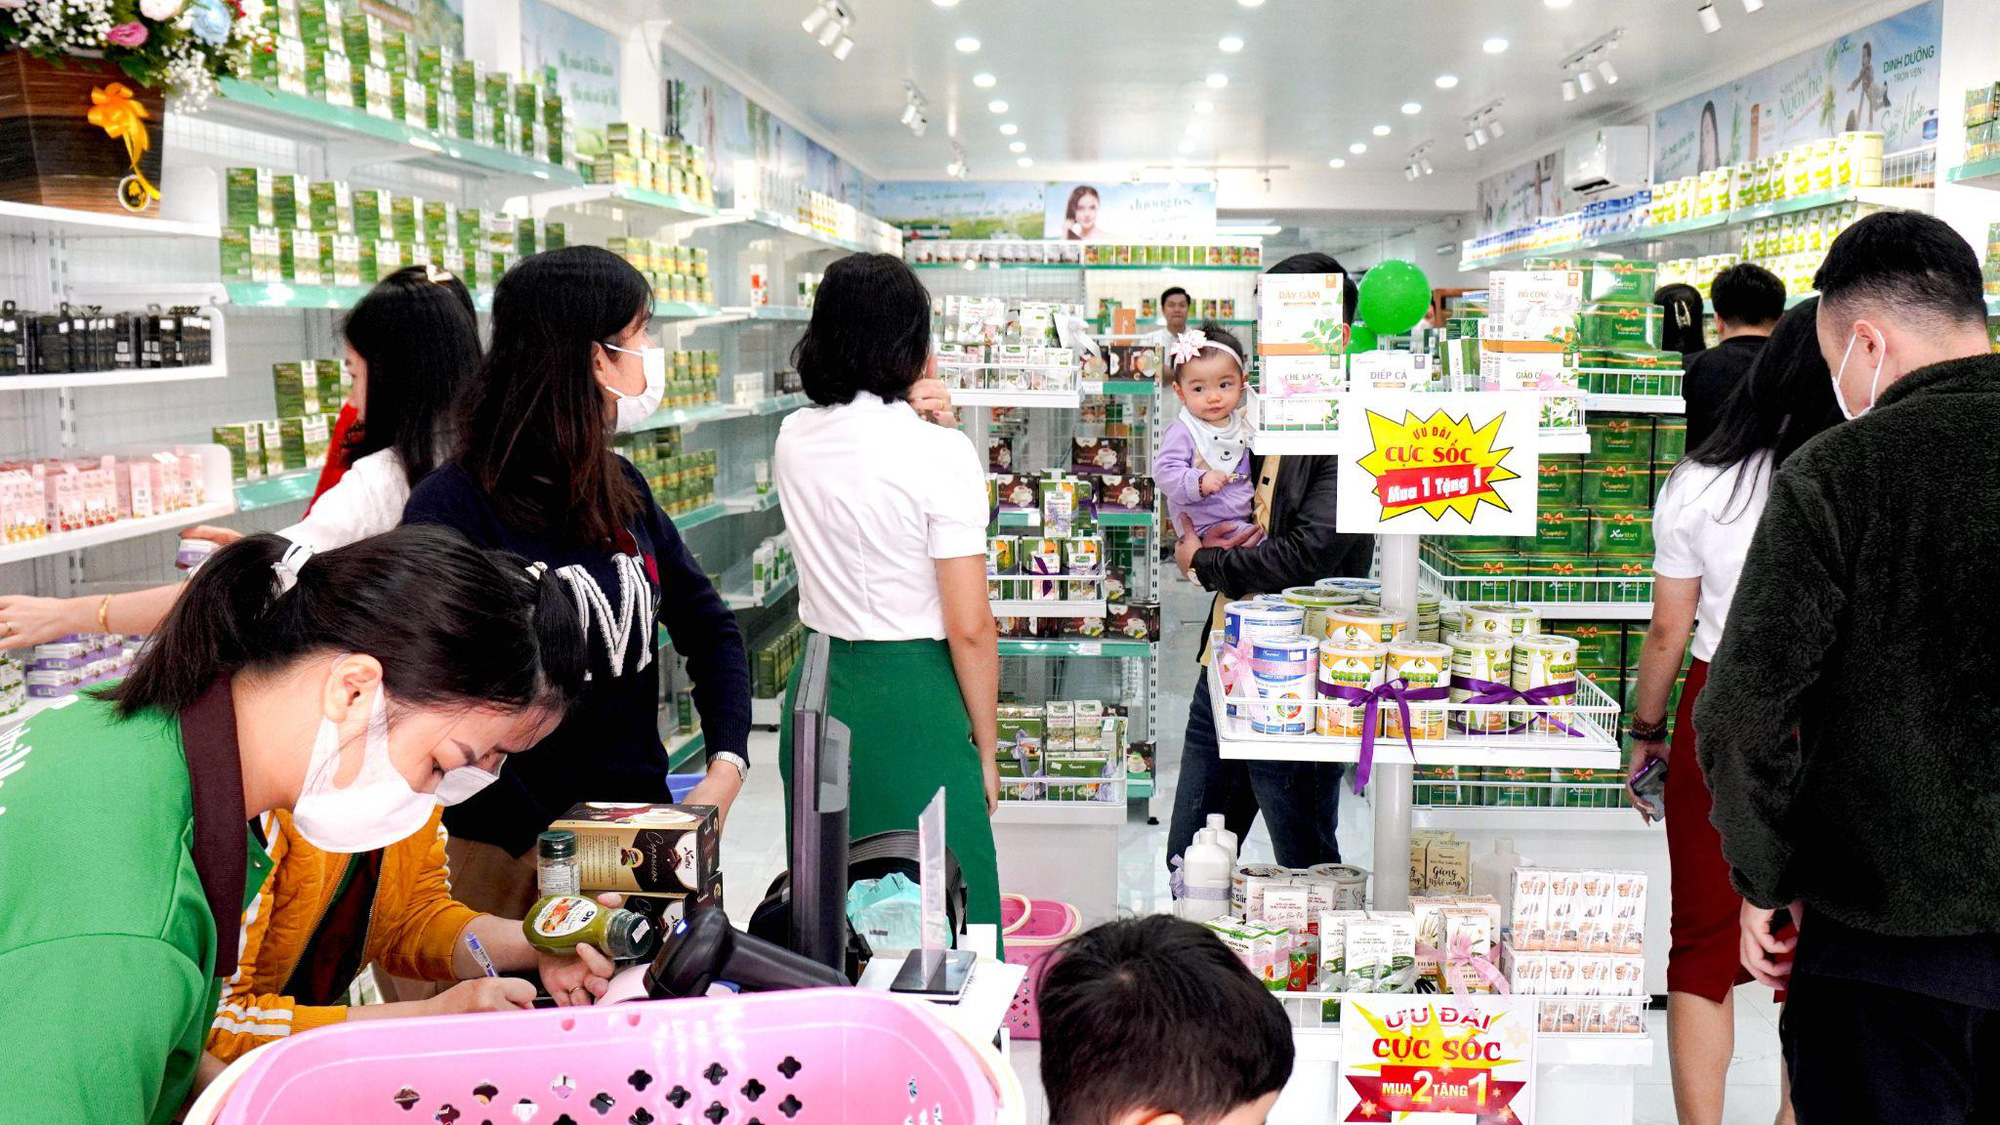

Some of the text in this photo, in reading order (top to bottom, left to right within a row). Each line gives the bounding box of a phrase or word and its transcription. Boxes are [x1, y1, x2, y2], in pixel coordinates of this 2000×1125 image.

[1385, 439, 1472, 467] CỰC SỐC
[1387, 468, 1482, 504] Mua 1 Tặng 1
[1372, 1033, 1502, 1063] CỰC SỐC
[1382, 1081, 1412, 1096] MUA
[1412, 1070, 1434, 1104] 2
[1468, 1072, 1488, 1107] 1
